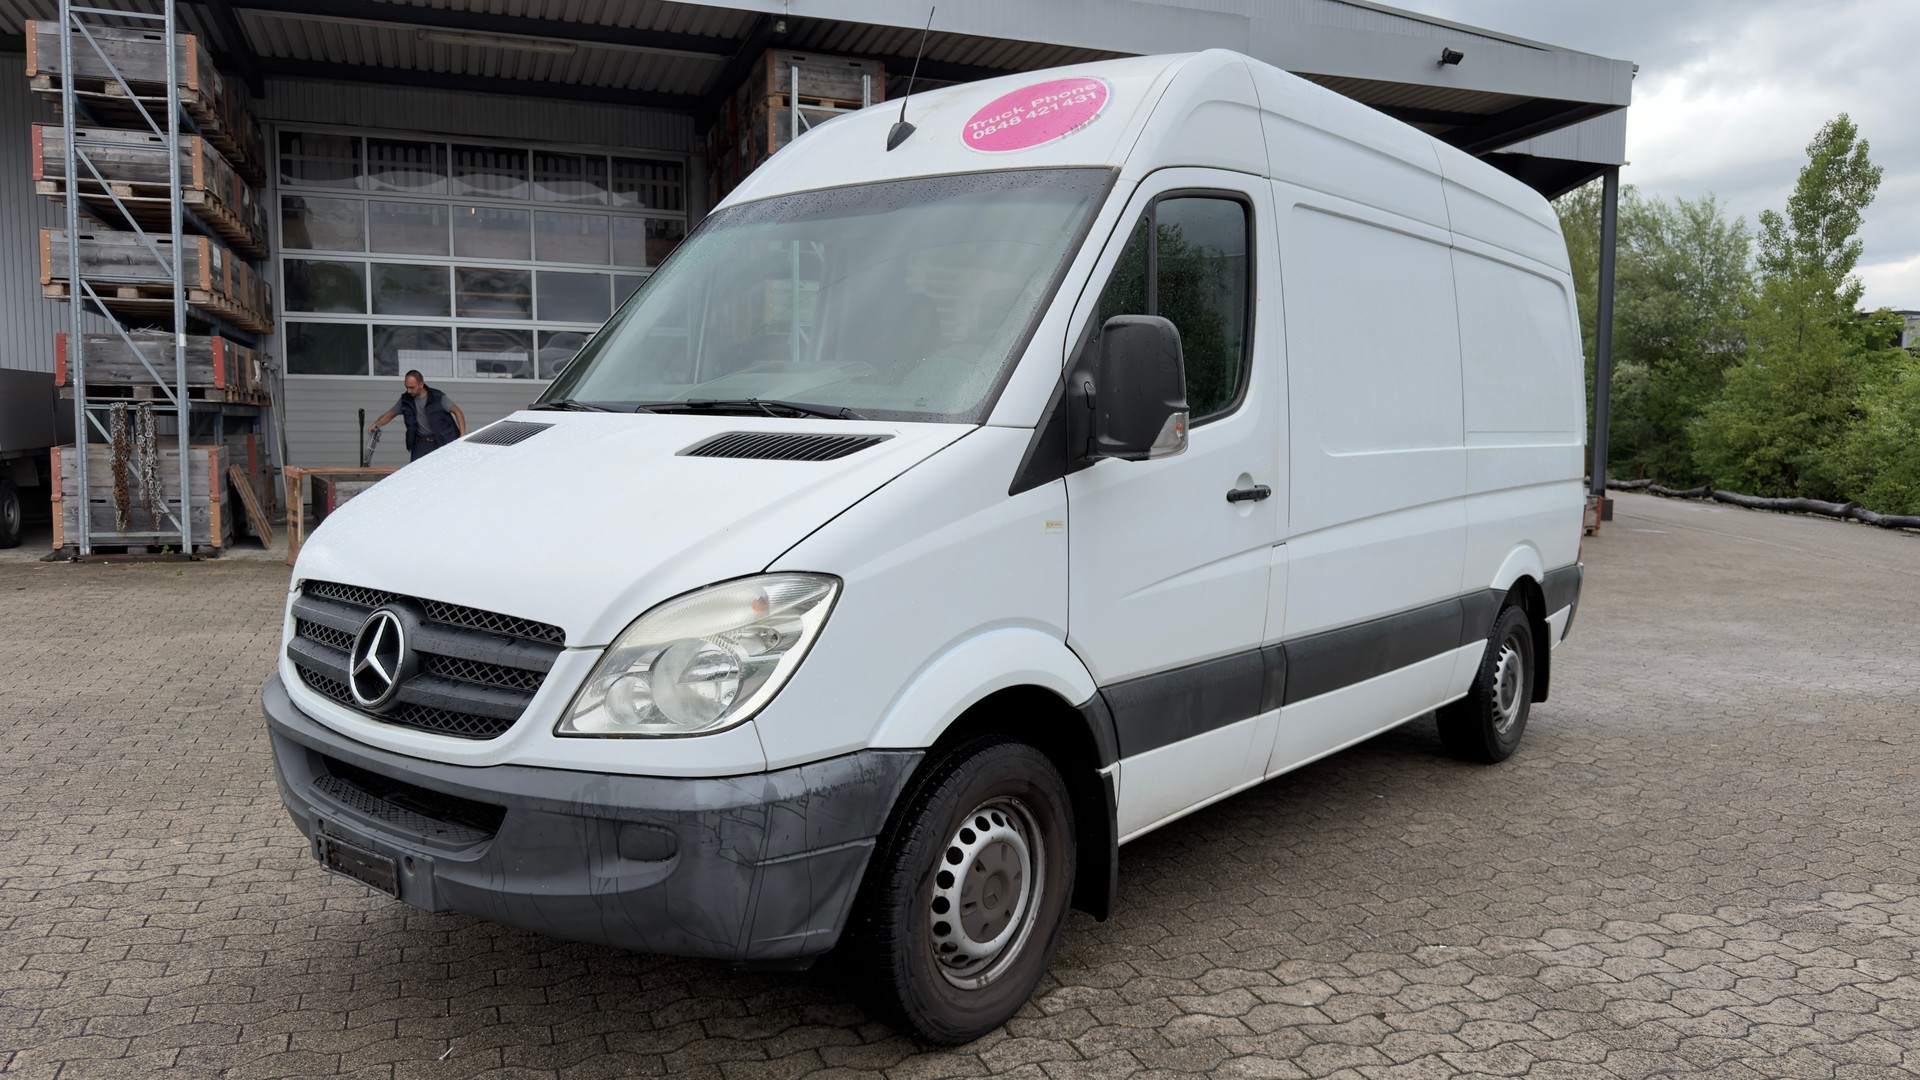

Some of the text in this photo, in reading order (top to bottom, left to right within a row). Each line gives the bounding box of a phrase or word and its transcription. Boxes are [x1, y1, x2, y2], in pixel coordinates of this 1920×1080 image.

[968, 83, 1097, 131] Truck Phone
[973, 91, 1097, 140] 0848 421 431
